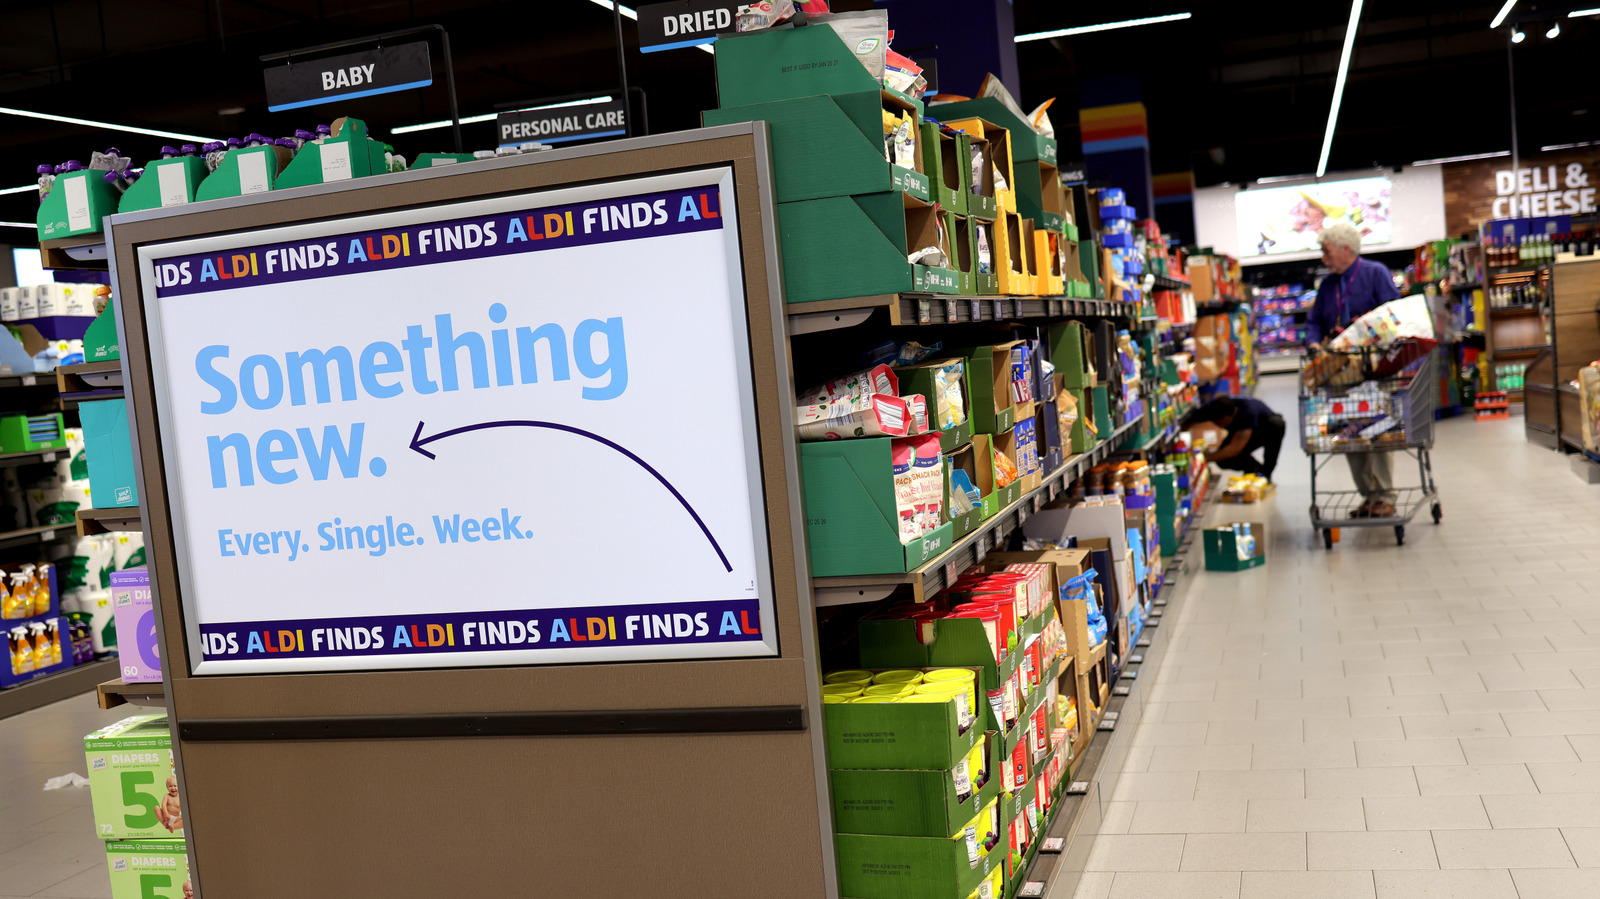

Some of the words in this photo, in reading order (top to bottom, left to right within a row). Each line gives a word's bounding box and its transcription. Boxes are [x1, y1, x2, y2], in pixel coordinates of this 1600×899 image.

[662, 8, 732, 37] DRIED
[321, 63, 375, 91] BABY
[501, 116, 582, 140] PERSONAL
[585, 110, 625, 129] CARE
[1495, 165, 1557, 196] DELI
[1565, 162, 1590, 188] &
[1492, 187, 1597, 221] CHEESE
[200, 253, 258, 282] ALDI
[265, 242, 340, 274] FINDS
[347, 232, 411, 263] ALDI
[418, 221, 498, 255] FINDS
[506, 210, 574, 244] ALDI
[583, 199, 669, 234] FINDS
[678, 192, 723, 223] AL
[195, 303, 628, 416] Something
[207, 423, 388, 489] new.
[911, 471, 931, 481] SNACK
[218, 529, 310, 562] Every.
[317, 516, 425, 557] Single.
[431, 508, 534, 544] Week.
[247, 629, 305, 654] ALDI
[311, 626, 385, 651] FINDS
[393, 624, 455, 649] ALDI
[462, 619, 541, 646] FINDS
[550, 617, 617, 643] ALDI
[625, 611, 710, 640] FINDS
[719, 609, 763, 636] AL
[123, 665, 138, 676] 60
[111, 753, 160, 764] DIAPERS
[120, 770, 161, 830] 5
[100, 823, 114, 834] 72
[131, 856, 177, 867] DIAPERS
